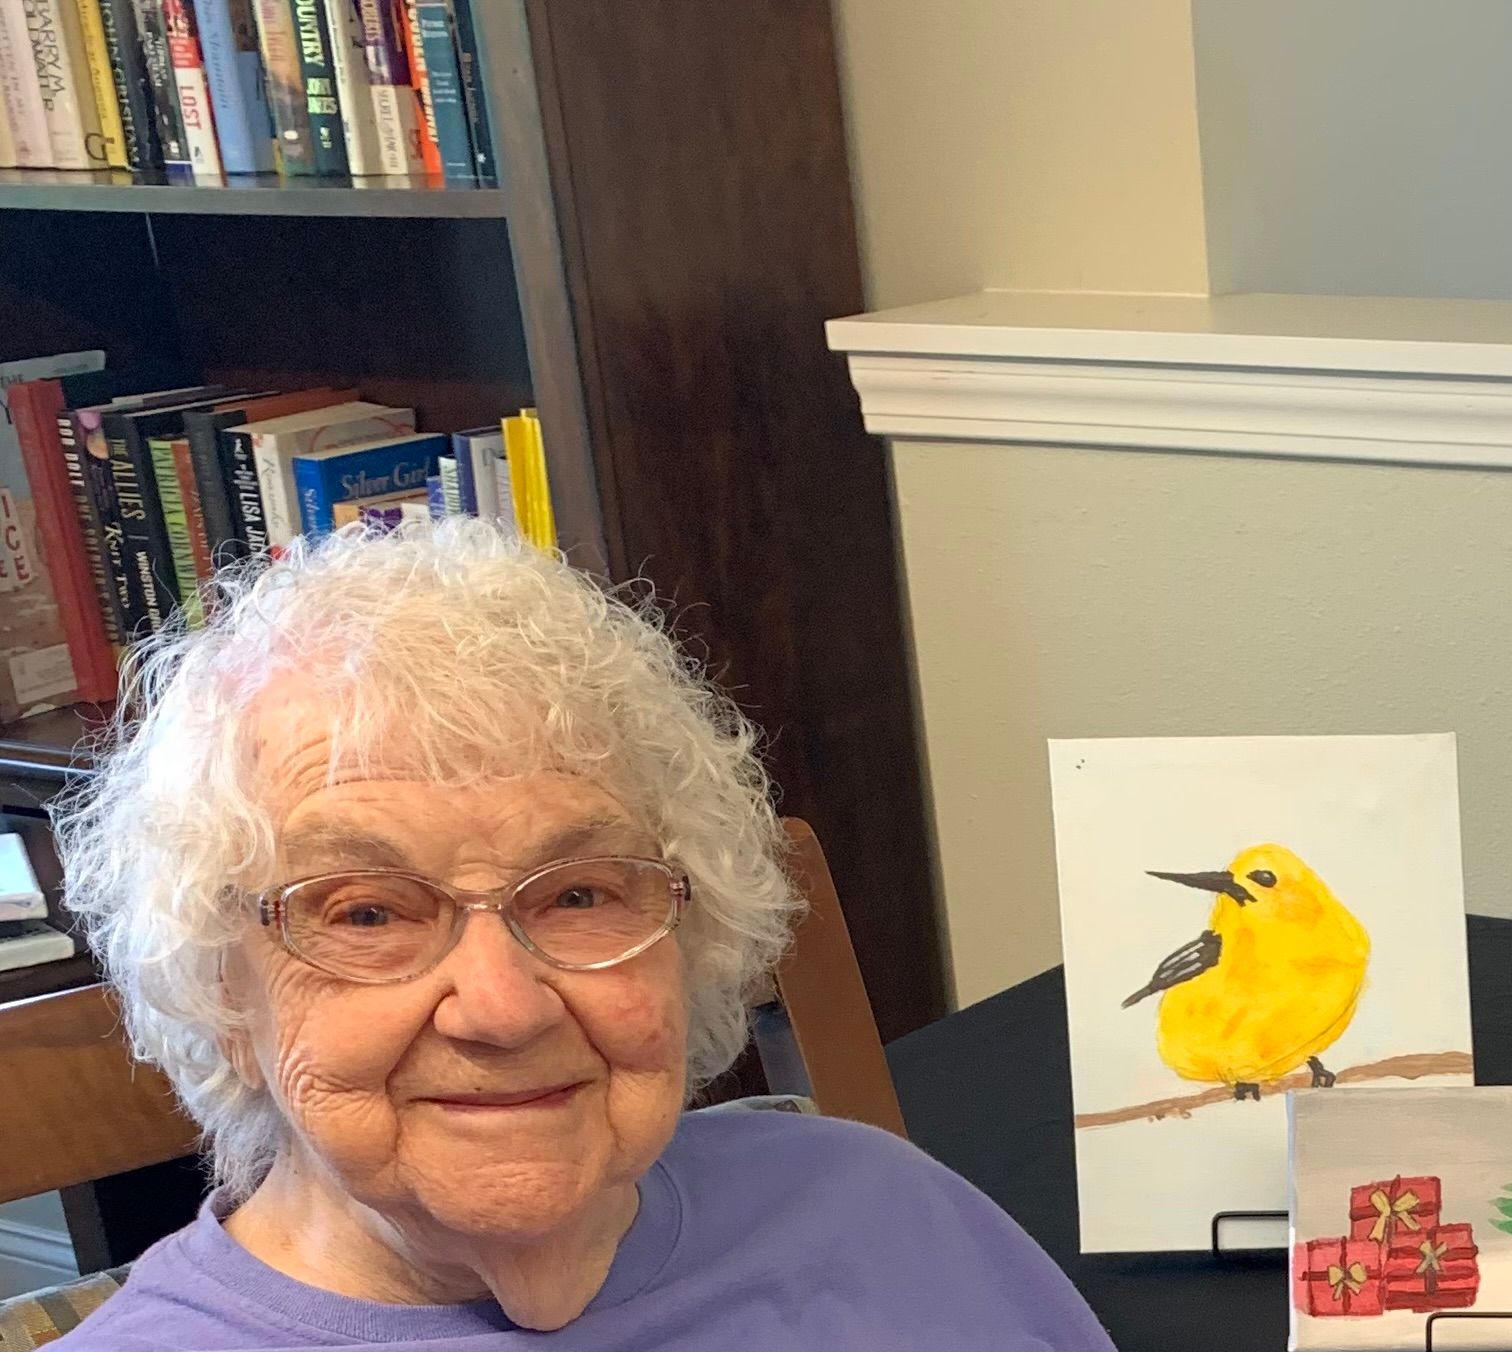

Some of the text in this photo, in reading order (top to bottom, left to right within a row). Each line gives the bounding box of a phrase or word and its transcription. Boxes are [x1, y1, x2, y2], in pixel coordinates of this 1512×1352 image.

[361, 0, 381, 41] OBERTS
[114, 67, 140, 163] GRISHAM
[180, 85, 202, 130] LOST
[109, 459, 146, 520] ALLIES
[151, 447, 187, 514] PATRICIA
[341, 457, 431, 497] Silver Girl
[239, 492, 262, 523] LISA
[136, 551, 159, 606] WINSTON
